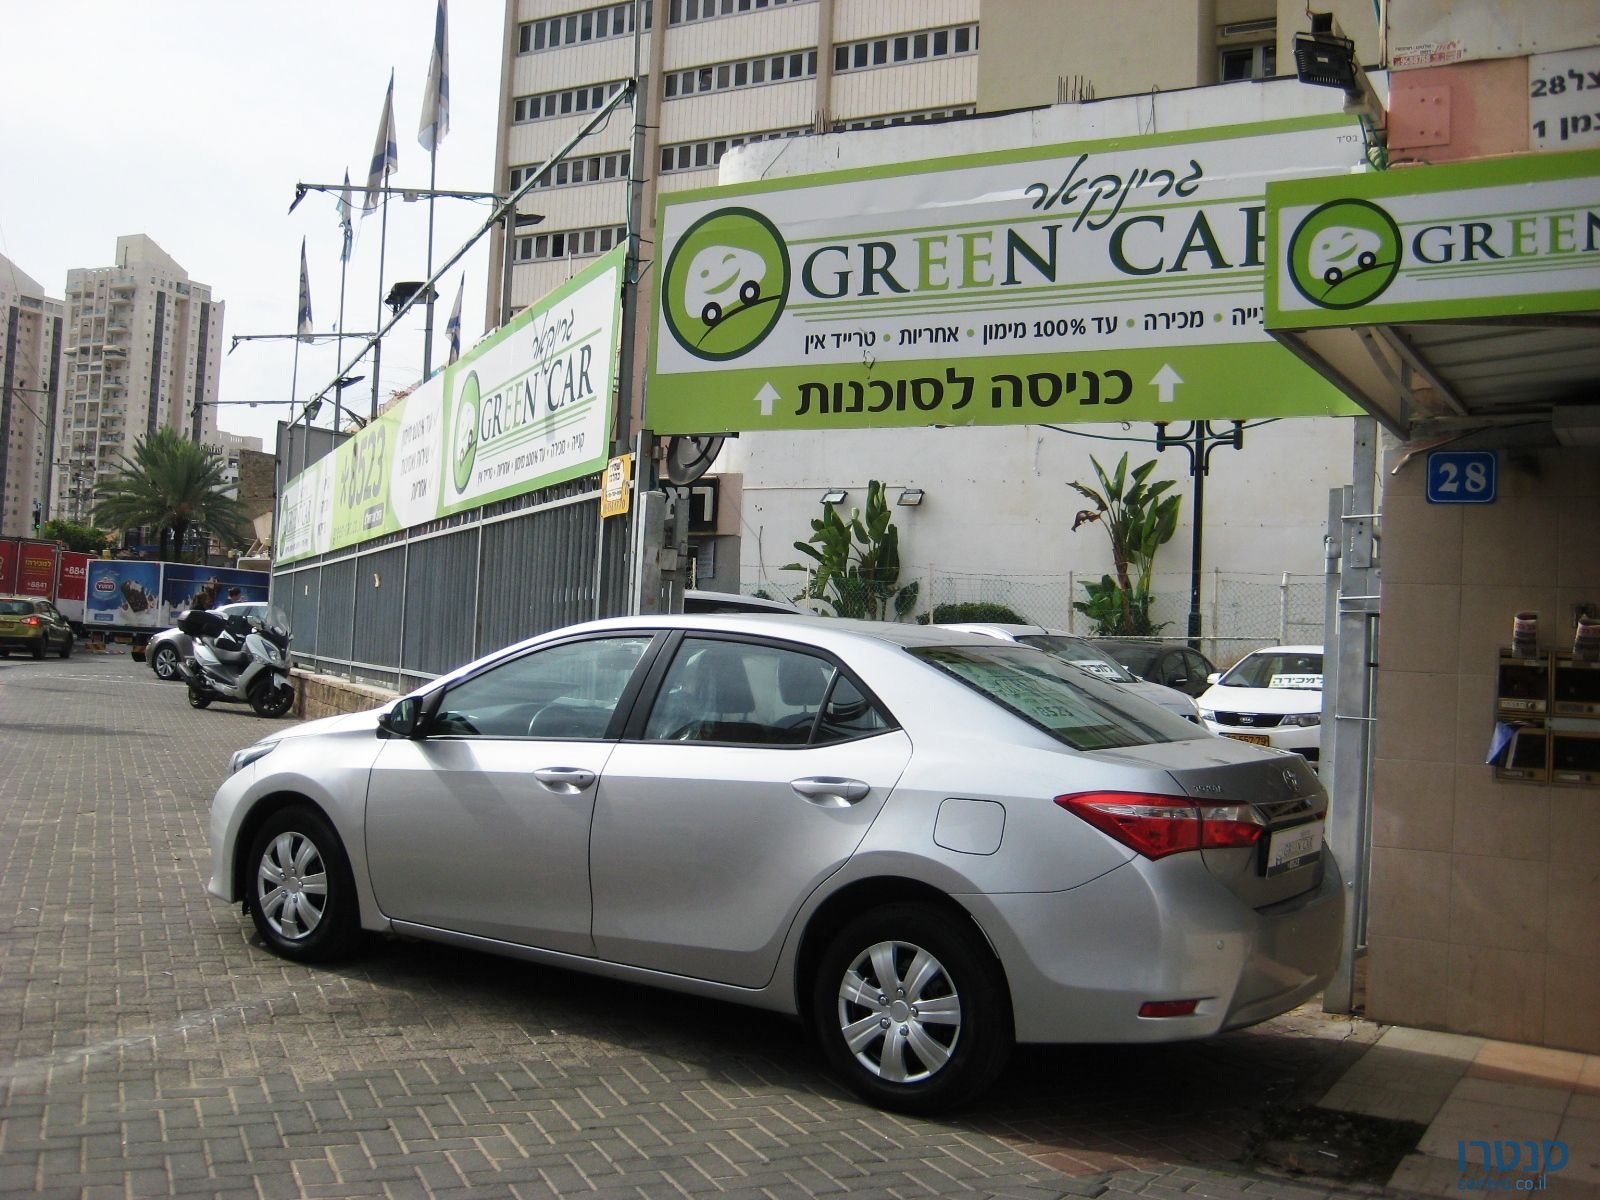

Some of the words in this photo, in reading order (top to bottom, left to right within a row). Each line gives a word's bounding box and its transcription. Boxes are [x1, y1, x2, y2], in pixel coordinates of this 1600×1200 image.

[1024, 153, 1203, 232] גרינקאר
[801, 224, 1063, 299] GREEN
[1033, 317, 1087, 338] 100%
[1091, 315, 1118, 335] עד
[1143, 310, 1204, 331] מכירה
[804, 332, 826, 355] אין
[830, 330, 876, 349] טרייד
[898, 326, 959, 346] אחריות
[983, 321, 1027, 345] מימון
[481, 371, 539, 442] GREEN
[547, 344, 593, 412] CAR
[795, 367, 975, 416] לסוכנות
[991, 369, 1133, 409] כניסה
[1438, 462, 1487, 493] 28
